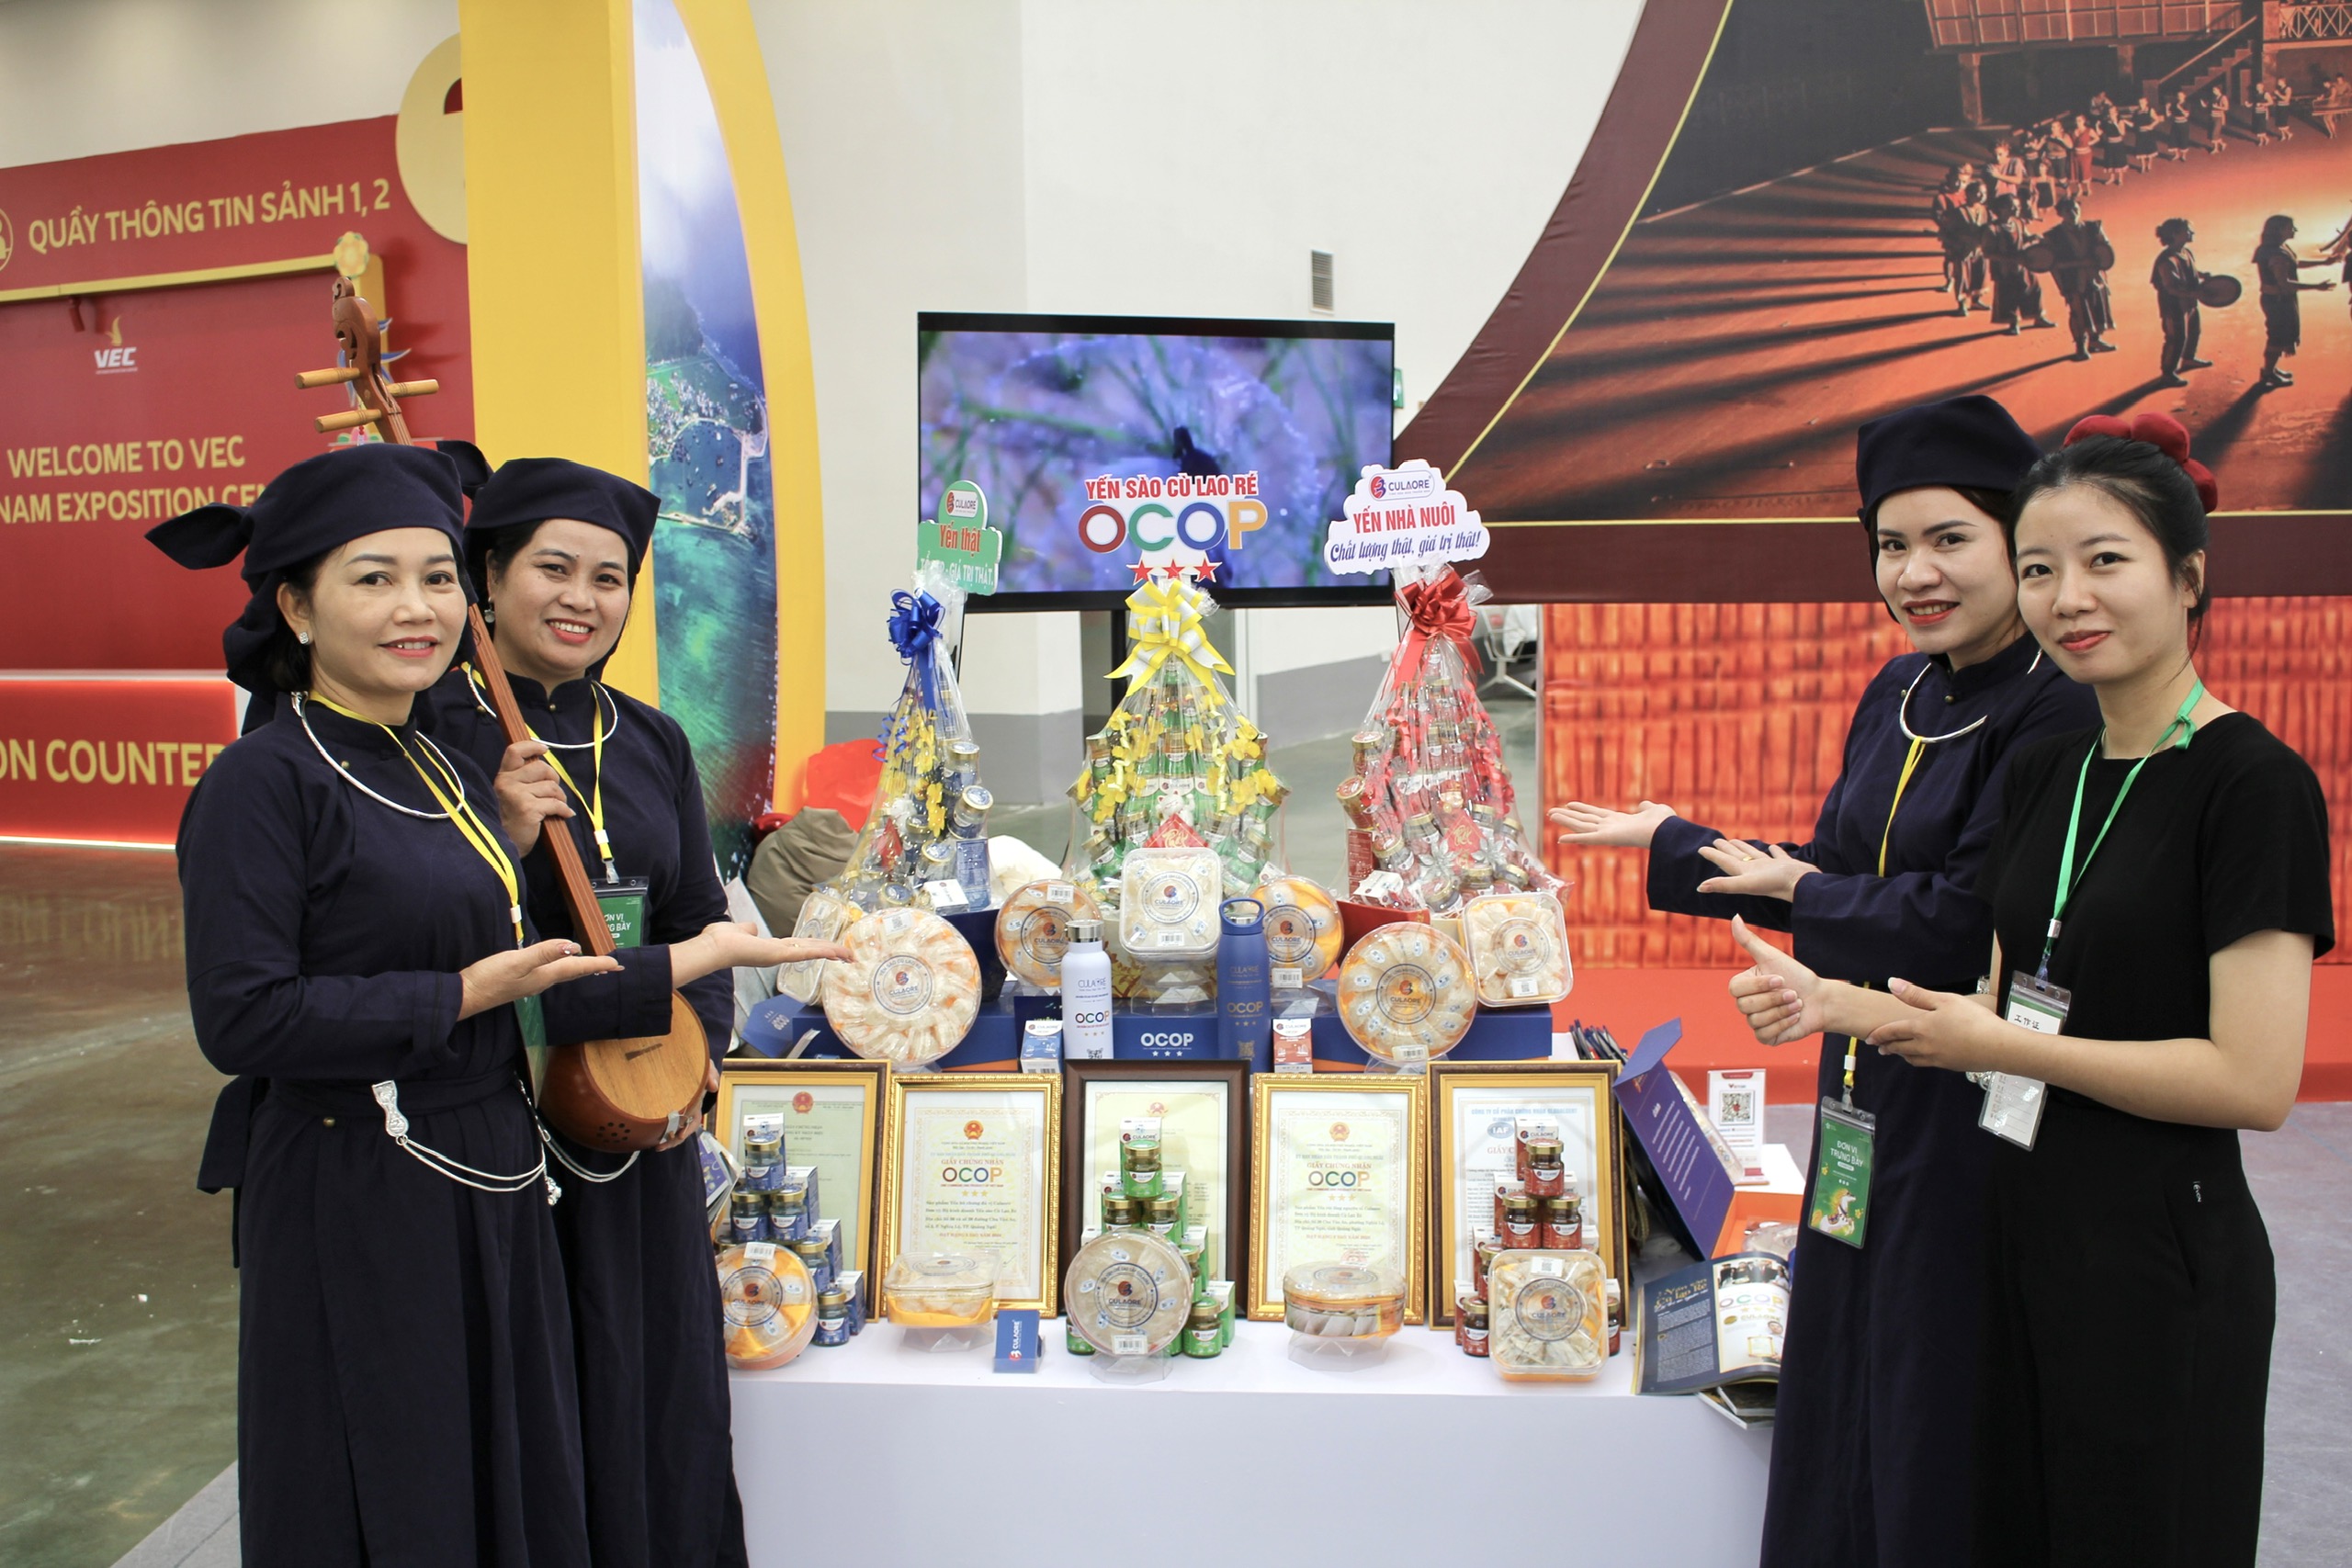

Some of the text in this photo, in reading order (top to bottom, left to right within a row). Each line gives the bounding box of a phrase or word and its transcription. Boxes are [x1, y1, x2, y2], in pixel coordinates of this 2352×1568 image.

[105, 199, 205, 242] THÔNG
[209, 195, 254, 229] TIN
[261, 180, 345, 223] SẢNH
[350, 182, 368, 217] 1,
[373, 178, 390, 210] 2
[95, 346, 137, 368] VEC
[7, 435, 245, 479] WELCOME TO VEC
[1086, 470, 1257, 500] YẾN SÀO CÙ LAO RÉ
[1389, 479, 1430, 491] CULAORE
[1079, 500, 1268, 553] OCOP
[1353, 501, 1455, 534] YẾN NHÀ NUÔI
[940, 521, 981, 557] Yến thật
[1330, 539, 1356, 562] Chất
[1359, 541, 1389, 562] lượng
[1419, 534, 1436, 558] giá
[1440, 532, 1453, 554] trị
[1455, 530, 1482, 552] thật!
[1227, 1000, 1263, 1013] OCOP
[1075, 1010, 1110, 1024] OCOP
[2014, 1013, 2040, 1031] 工作证
[1140, 1032, 1194, 1047] OCOP
[943, 1168, 1002, 1182] OCOP
[1308, 1171, 1370, 1187] OCOP
[1720, 1293, 1784, 1308] OCOP
